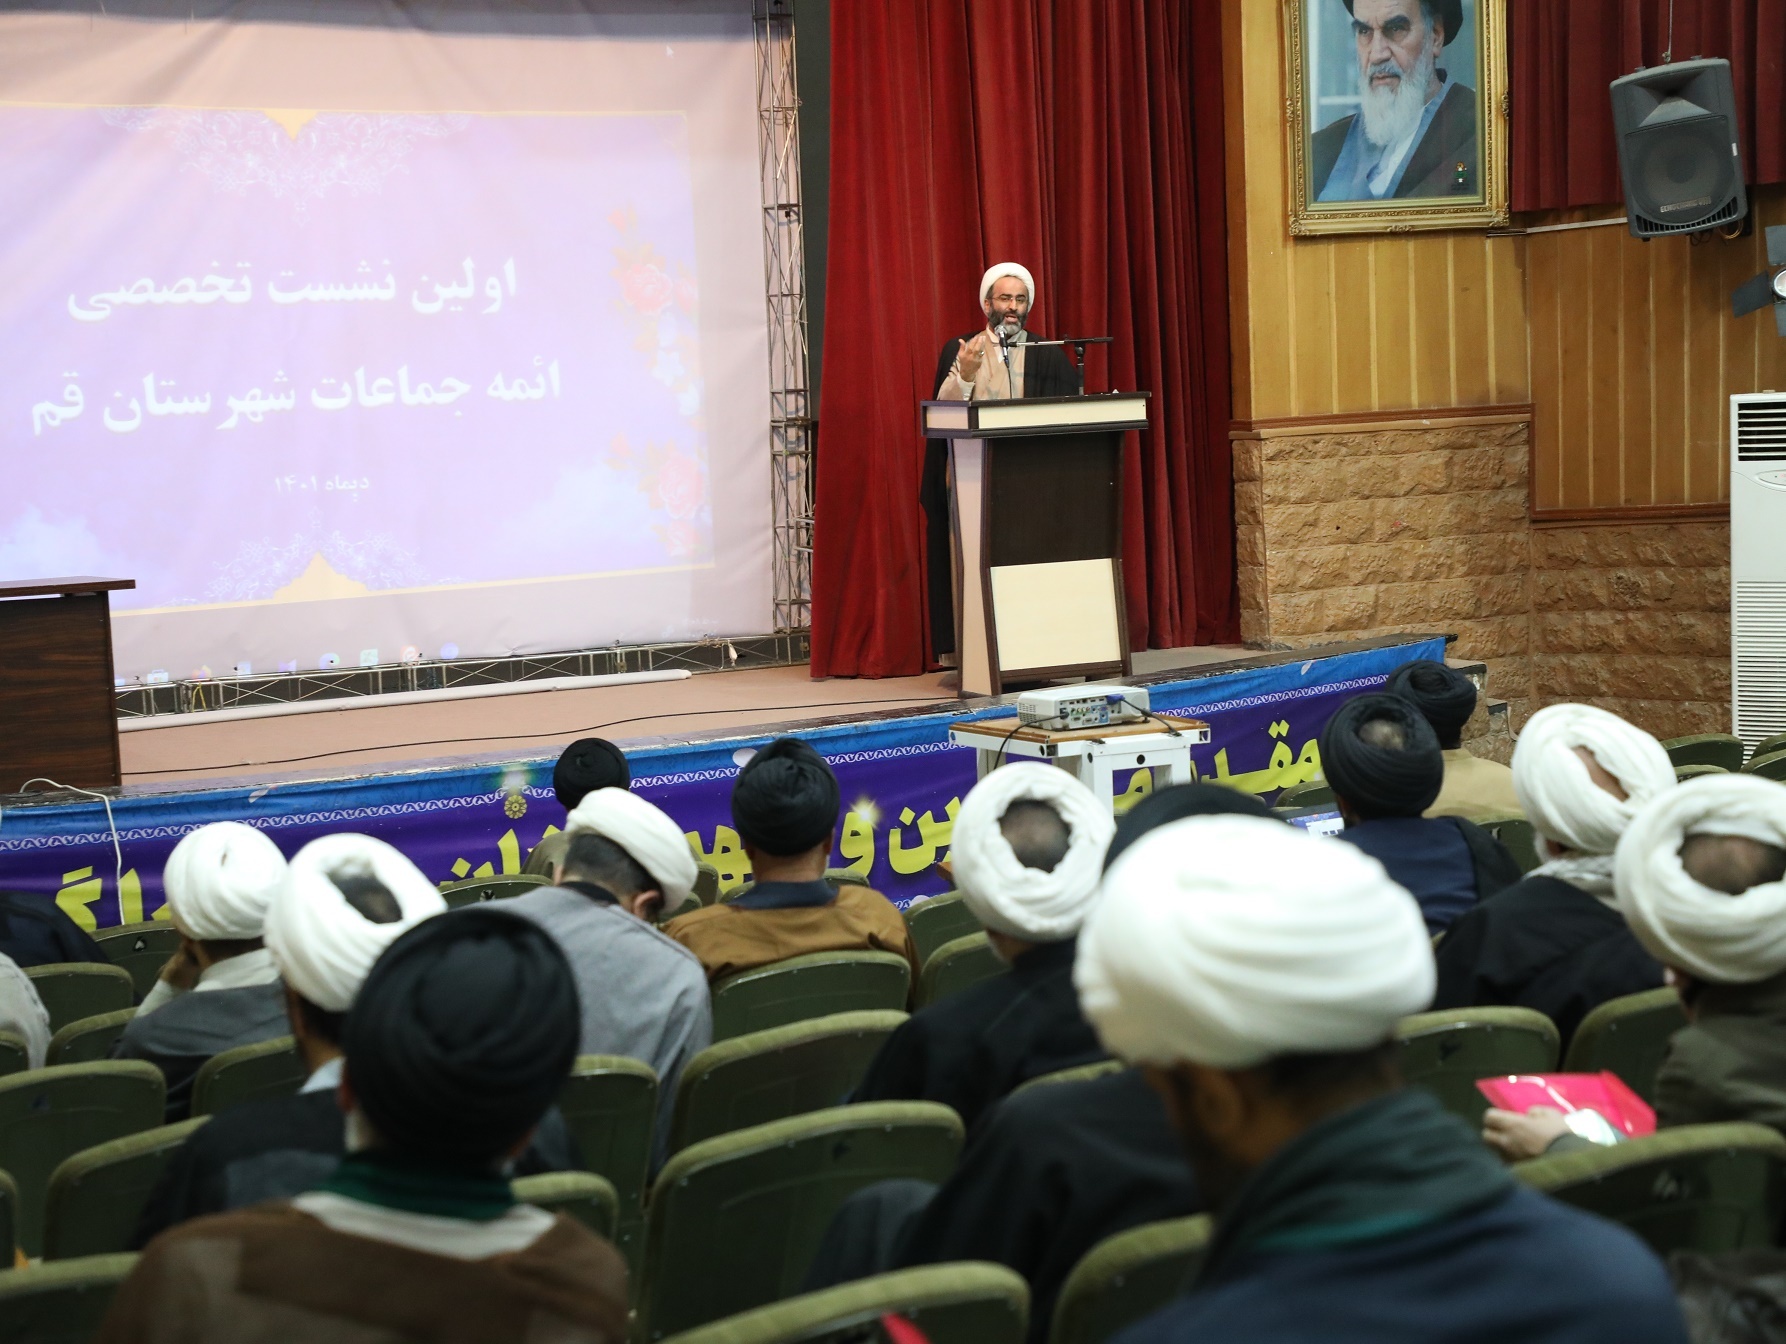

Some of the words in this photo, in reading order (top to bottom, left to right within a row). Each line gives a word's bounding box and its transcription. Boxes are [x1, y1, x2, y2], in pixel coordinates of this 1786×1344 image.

[67, 260, 252, 321] تخصصی
[267, 258, 396, 304] نشست
[411, 256, 516, 315] اولین
[32, 370, 84, 437] قم
[102, 369, 296, 434] شهرستان
[310, 364, 472, 417] جماعات
[486, 355, 560, 401] ائمه
[274, 474, 318, 494] ۱۴۰۱
